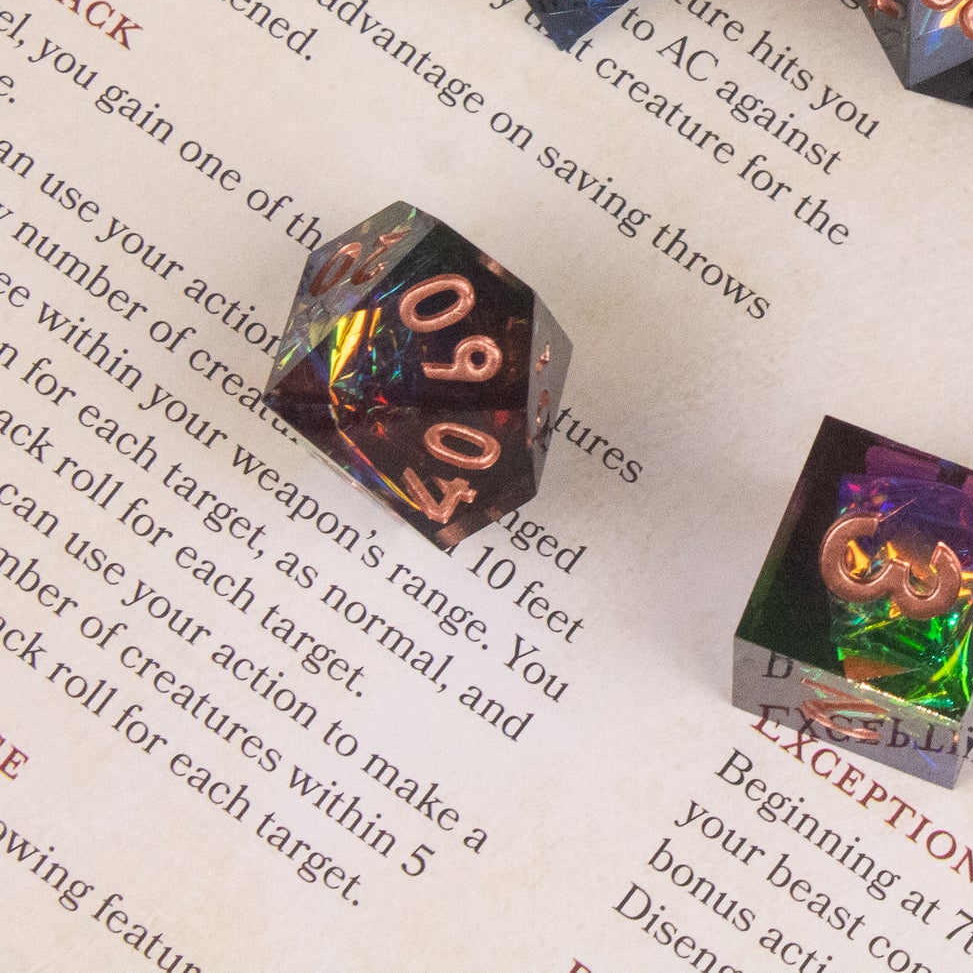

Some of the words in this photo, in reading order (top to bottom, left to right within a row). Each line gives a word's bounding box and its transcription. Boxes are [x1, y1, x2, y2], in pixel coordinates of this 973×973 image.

[93, 84, 174, 146] gain
[594, 56, 735, 165] creature
[654, 34, 720, 82] AC
[714, 79, 842, 176] against
[745, 28, 815, 92] hits
[807, 83, 880, 140] you
[9, 220, 149, 322] number
[535, 144, 652, 239] saving
[650, 222, 772, 320] throws
[36, 300, 143, 393] within
[384, 562, 489, 651] range.
[502, 632, 570, 704] You
[52, 455, 125, 511] roll
[173, 545, 256, 615] each
[259, 602, 365, 698] target.
[511, 579, 585, 644] feet
[818, 513, 963, 620] 3
[0, 482, 59, 539] can
[63, 531, 126, 586] use
[210, 643, 318, 731] action
[359, 752, 460, 832] make
[318, 583, 455, 694] normal,
[118, 644, 283, 773] creatures
[399, 842, 436, 877] 5
[168, 752, 251, 823] each
[254, 810, 362, 907] target.
[712, 746, 902, 901] Beginning
[646, 836, 756, 932] bonus
[764, 852, 866, 941] beast
